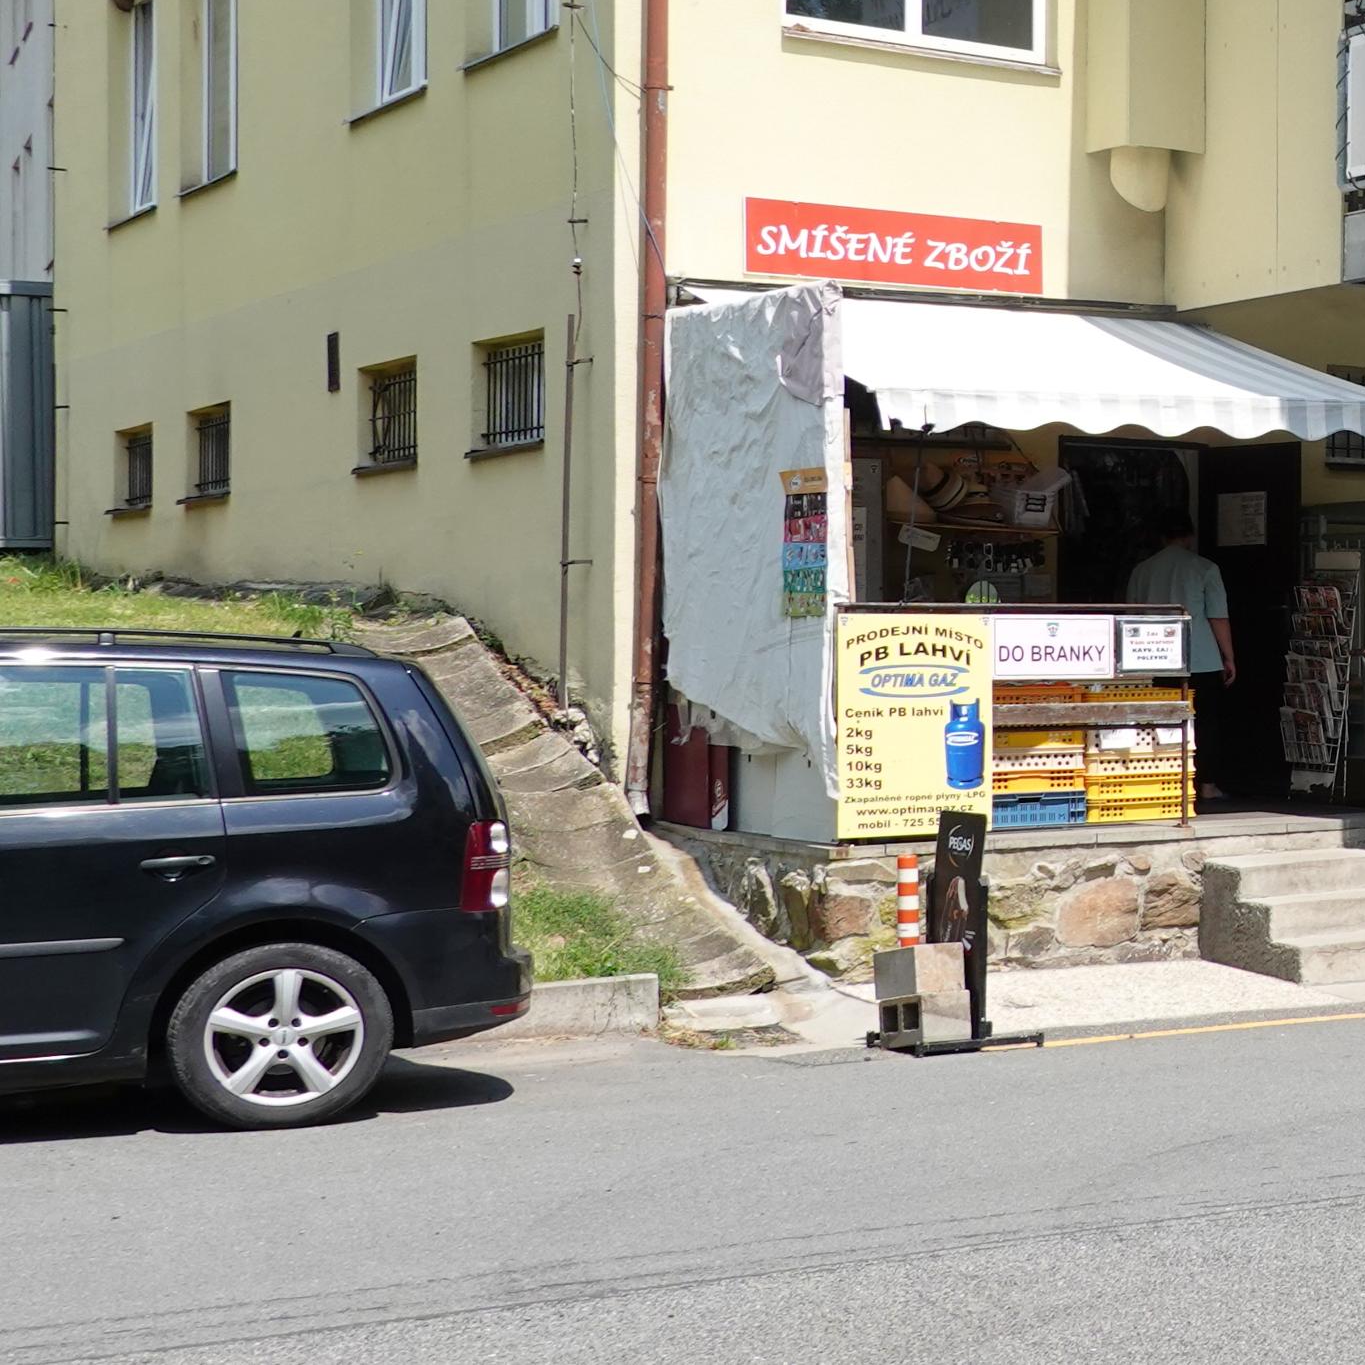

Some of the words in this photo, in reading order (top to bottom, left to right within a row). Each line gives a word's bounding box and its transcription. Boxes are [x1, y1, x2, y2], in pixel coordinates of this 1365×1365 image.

[756, 224, 916, 265] SMÍŠENÉ
[923, 239, 1032, 276] ZBOŽÍ
[846, 623, 929, 649] PRODEJNÍ
[935, 627, 984, 649] MÍSTO
[859, 645, 889, 667] PB
[899, 641, 972, 666] LAHVÍ
[998, 645, 1025, 662] DO
[1031, 645, 1105, 662] BRANKY
[871, 673, 924, 688] OPTIMA
[928, 673, 959, 687] GAZ
[889, 707, 907, 717] PB
[846, 727, 873, 740] 2kg
[846, 744, 873, 756] 5kg
[846, 760, 883, 773] 10kg
[846, 777, 883, 790] 33kg
[905, 793, 933, 803] ropné
[856, 804, 974, 816] www.optimagaz.cz
[857, 819, 891, 830] mobil
[903, 818, 924, 828] 725
[948, 836, 972, 851] PEGAS
